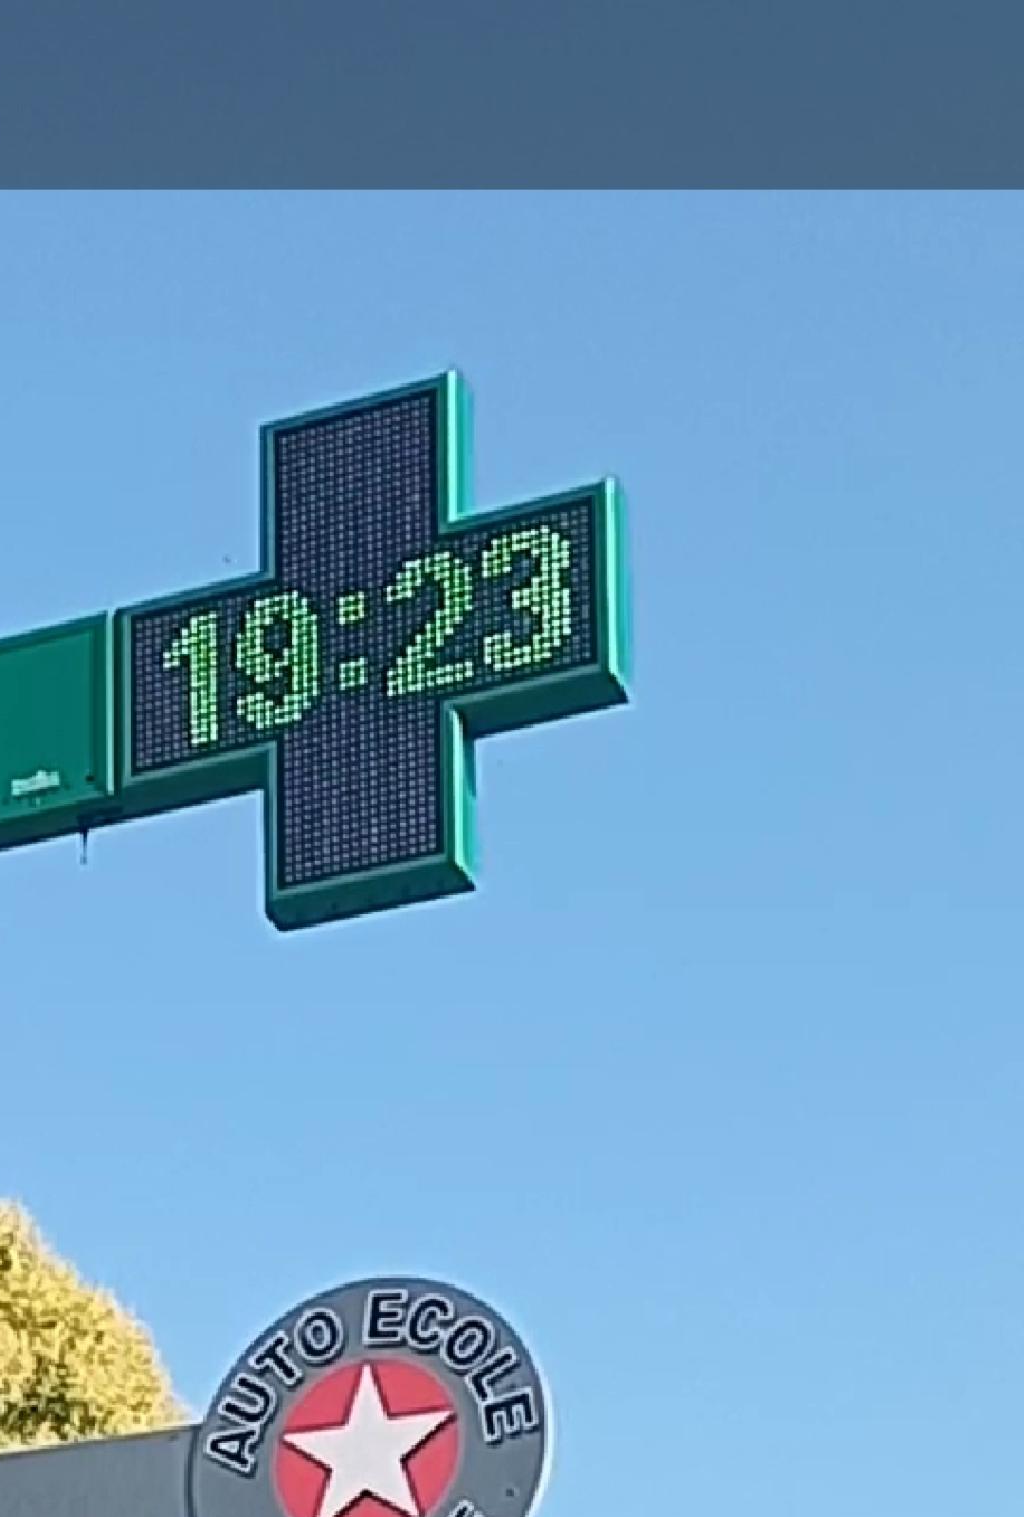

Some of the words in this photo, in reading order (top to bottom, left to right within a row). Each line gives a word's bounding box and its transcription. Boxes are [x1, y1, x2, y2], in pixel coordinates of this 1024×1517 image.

[162, 524, 572, 747] 19:23
[206, 1308, 343, 1472] AUTO
[362, 1289, 539, 1444] ECOLE
